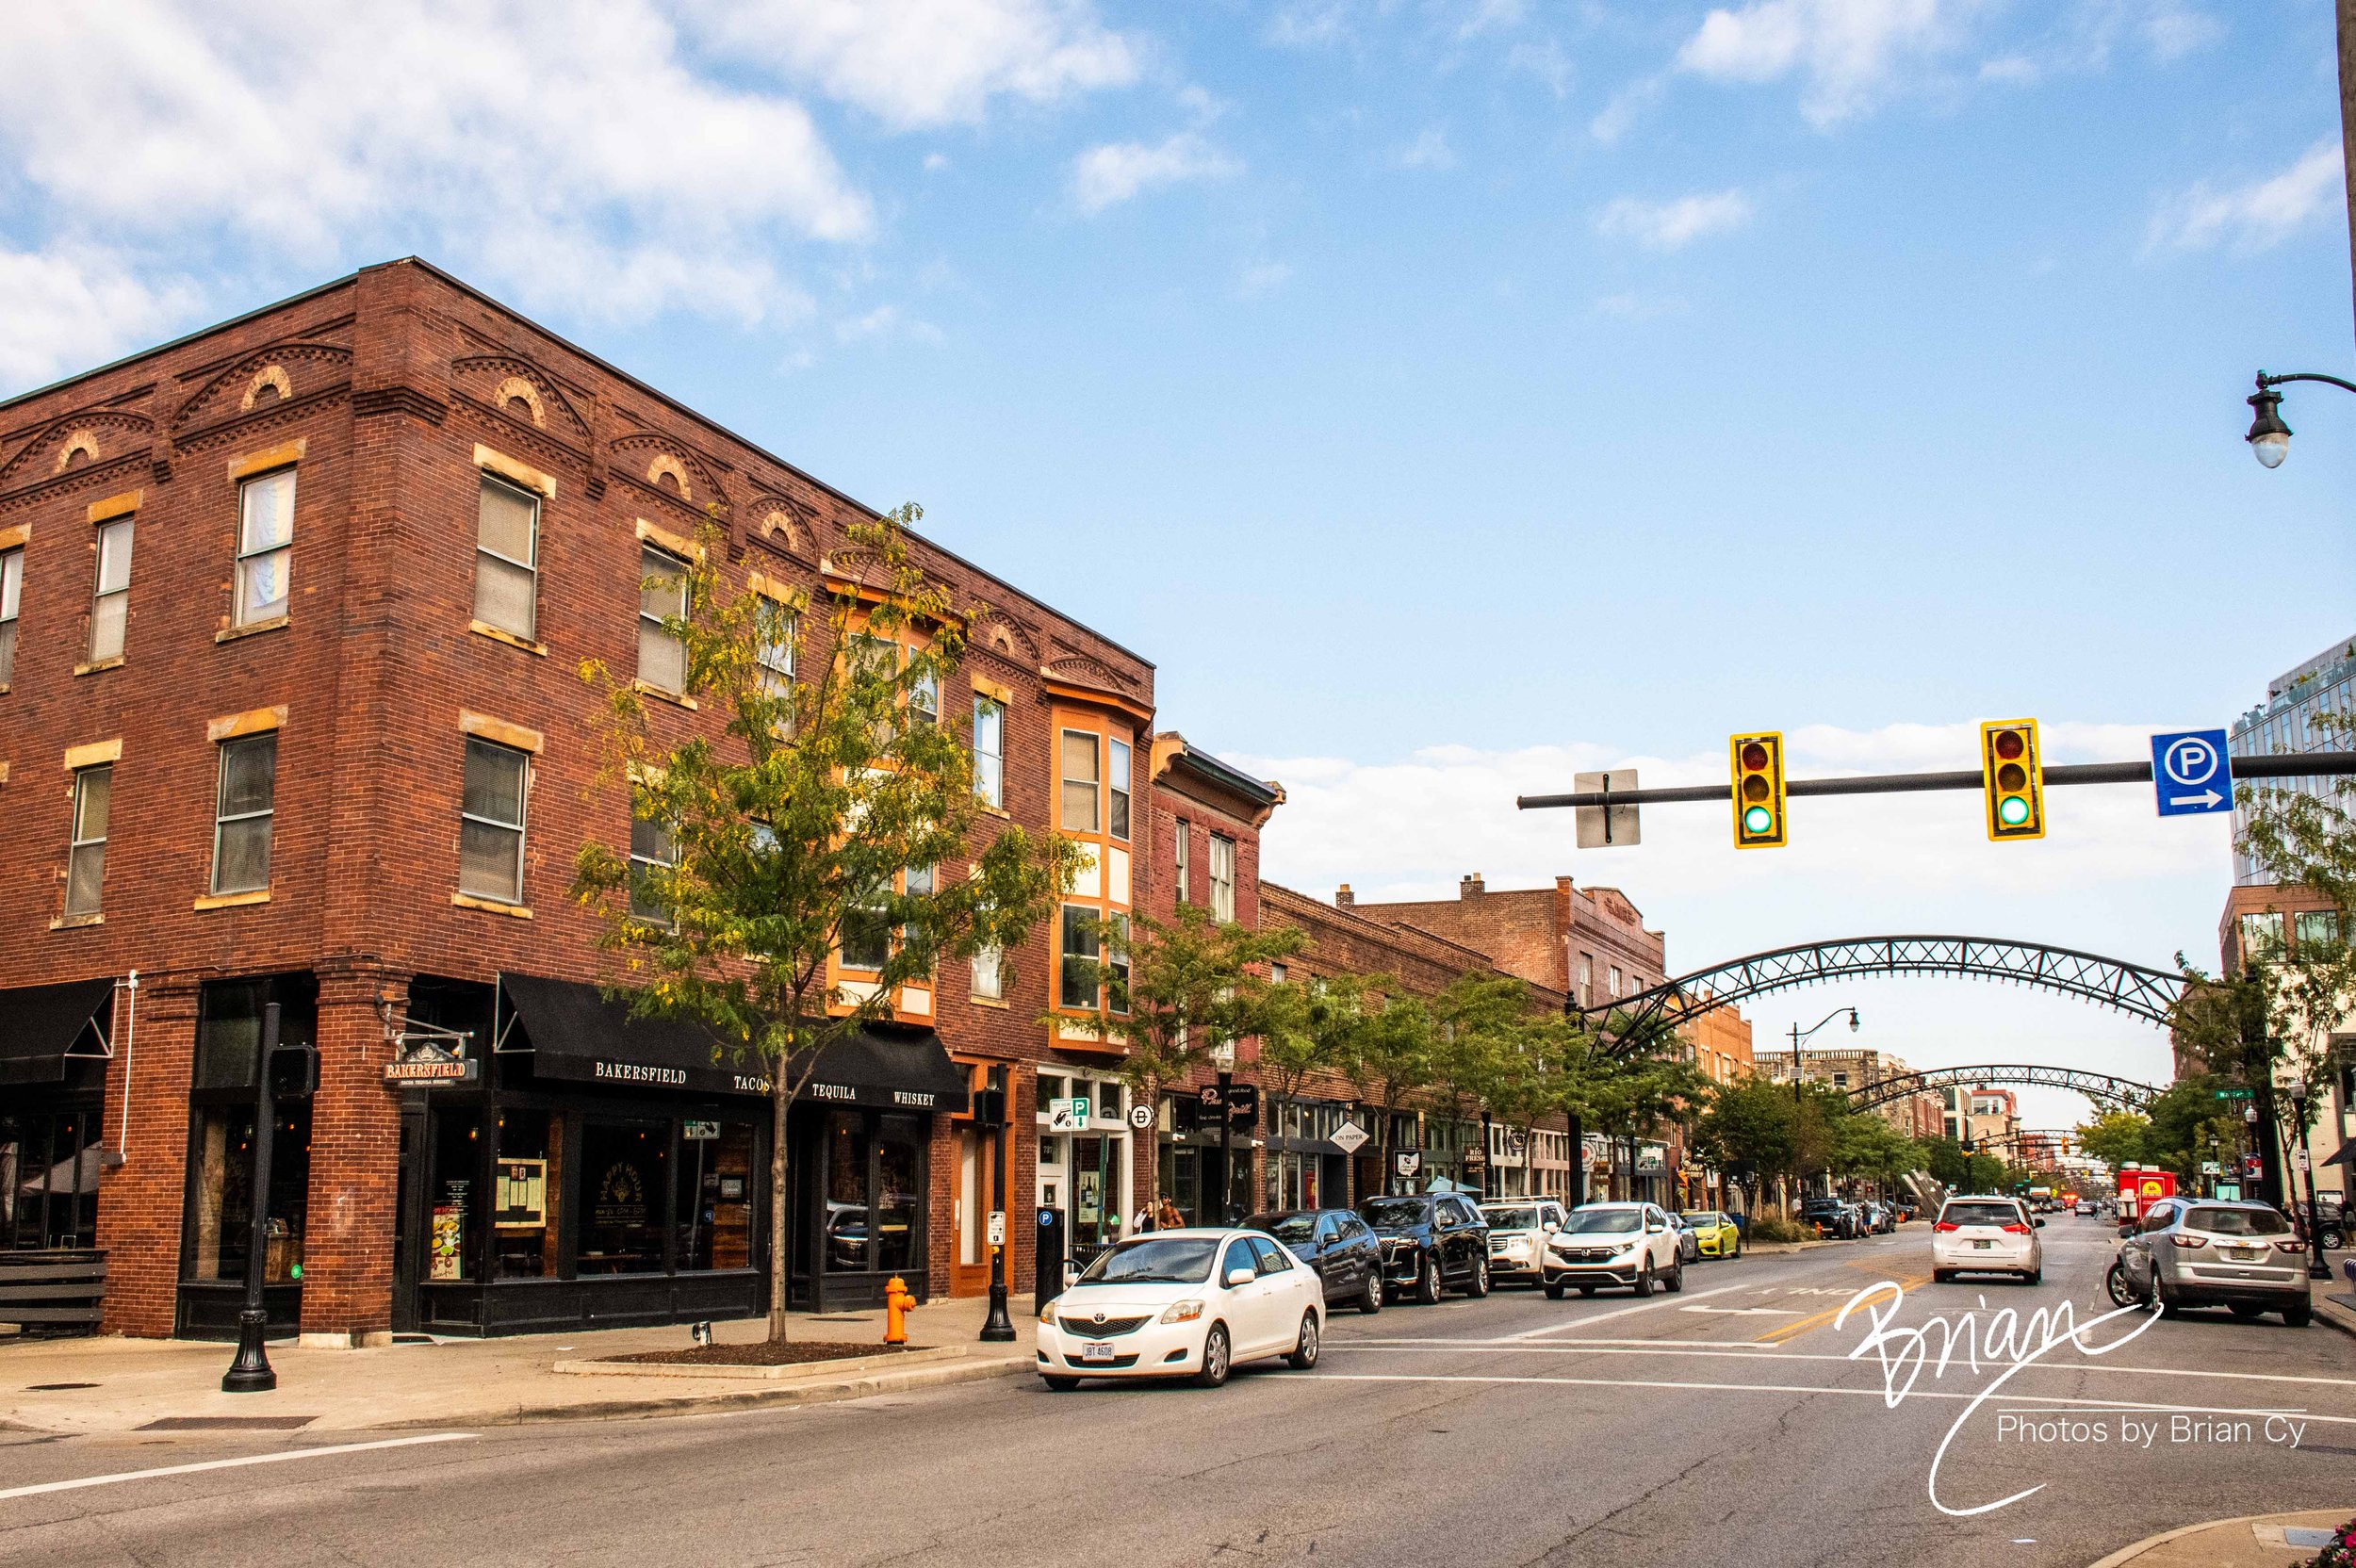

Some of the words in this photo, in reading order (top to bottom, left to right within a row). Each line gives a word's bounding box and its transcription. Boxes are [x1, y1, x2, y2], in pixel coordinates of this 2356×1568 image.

[2180, 746, 2206, 776] P
[385, 1062, 466, 1079] BAKERSFIELD
[595, 1061, 687, 1085] BAKERSFIELD
[734, 1075, 770, 1092] TACOS
[812, 1083, 857, 1101] TEQUILA
[894, 1090, 935, 1107] WHISKEY
[1075, 1102, 1085, 1115] P
[625, 1162, 643, 1202] HOUR
[1042, 1214, 1050, 1223] P
